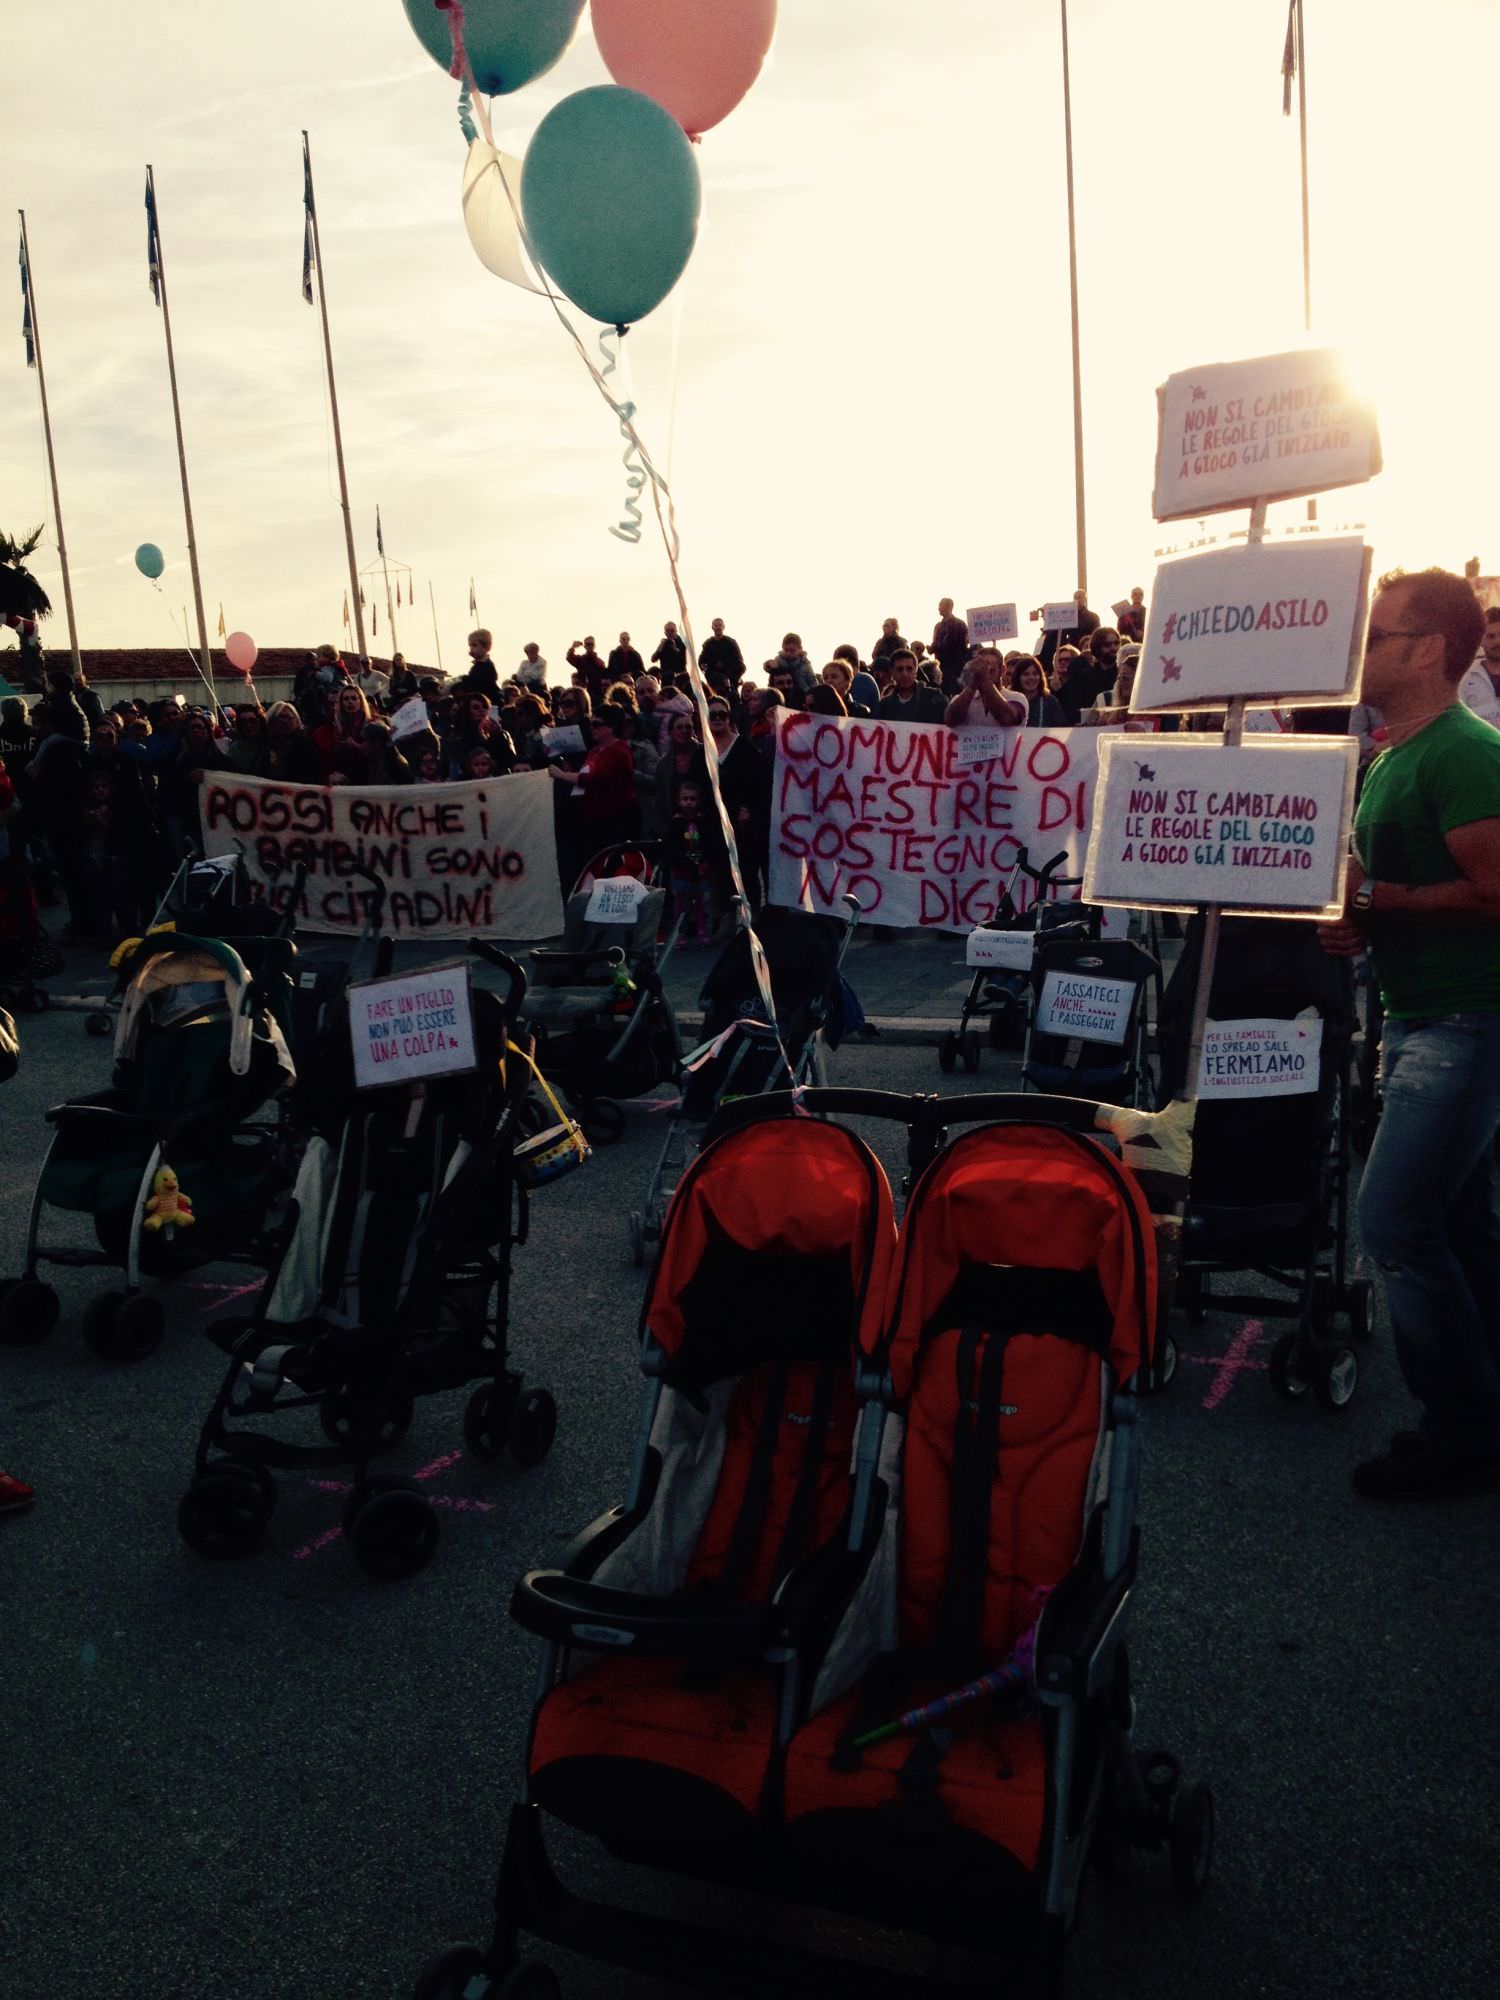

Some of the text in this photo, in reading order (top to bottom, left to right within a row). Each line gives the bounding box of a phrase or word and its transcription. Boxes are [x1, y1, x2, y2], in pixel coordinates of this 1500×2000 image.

[1184, 405, 1218, 433] NON
[1224, 397, 1245, 424] SI
[1181, 434, 1201, 457] LE
[1203, 421, 1258, 451] REGOLE
[1178, 460, 1188, 479] A
[1193, 450, 1237, 475] GIOCO
[1162, 597, 1328, 644] #CHIEDOASILO
[780, 765, 1086, 833] MAESTRE DI
[1128, 789, 1318, 822] NON SI CAMBIANO
[349, 799, 466, 837] ANCHE
[1125, 816, 1315, 846] LE REGOLE DEL GIOCO
[779, 813, 1023, 875] SOSTEGNO
[1121, 842, 1133, 862] A
[1139, 842, 1188, 864] GIOCO
[1231, 845, 1312, 870] INIZIATO
[426, 846, 524, 880] SONO
[799, 859, 883, 914] NO
[367, 988, 455, 1020] FARE UN FIGLIO
[1051, 995, 1086, 1013] ANCHE
[1056, 980, 1121, 1004] TASSATECI
[368, 1023, 390, 1040] NON
[415, 1007, 457, 1031] ESSERE
[1058, 1011, 1116, 1031] PASSEGGINI
[370, 1030, 447, 1063] UNA COLPA
[1205, 1041, 1290, 1054] LO SPREAD SALE
[1205, 1054, 1305, 1075] FERMIAMO
